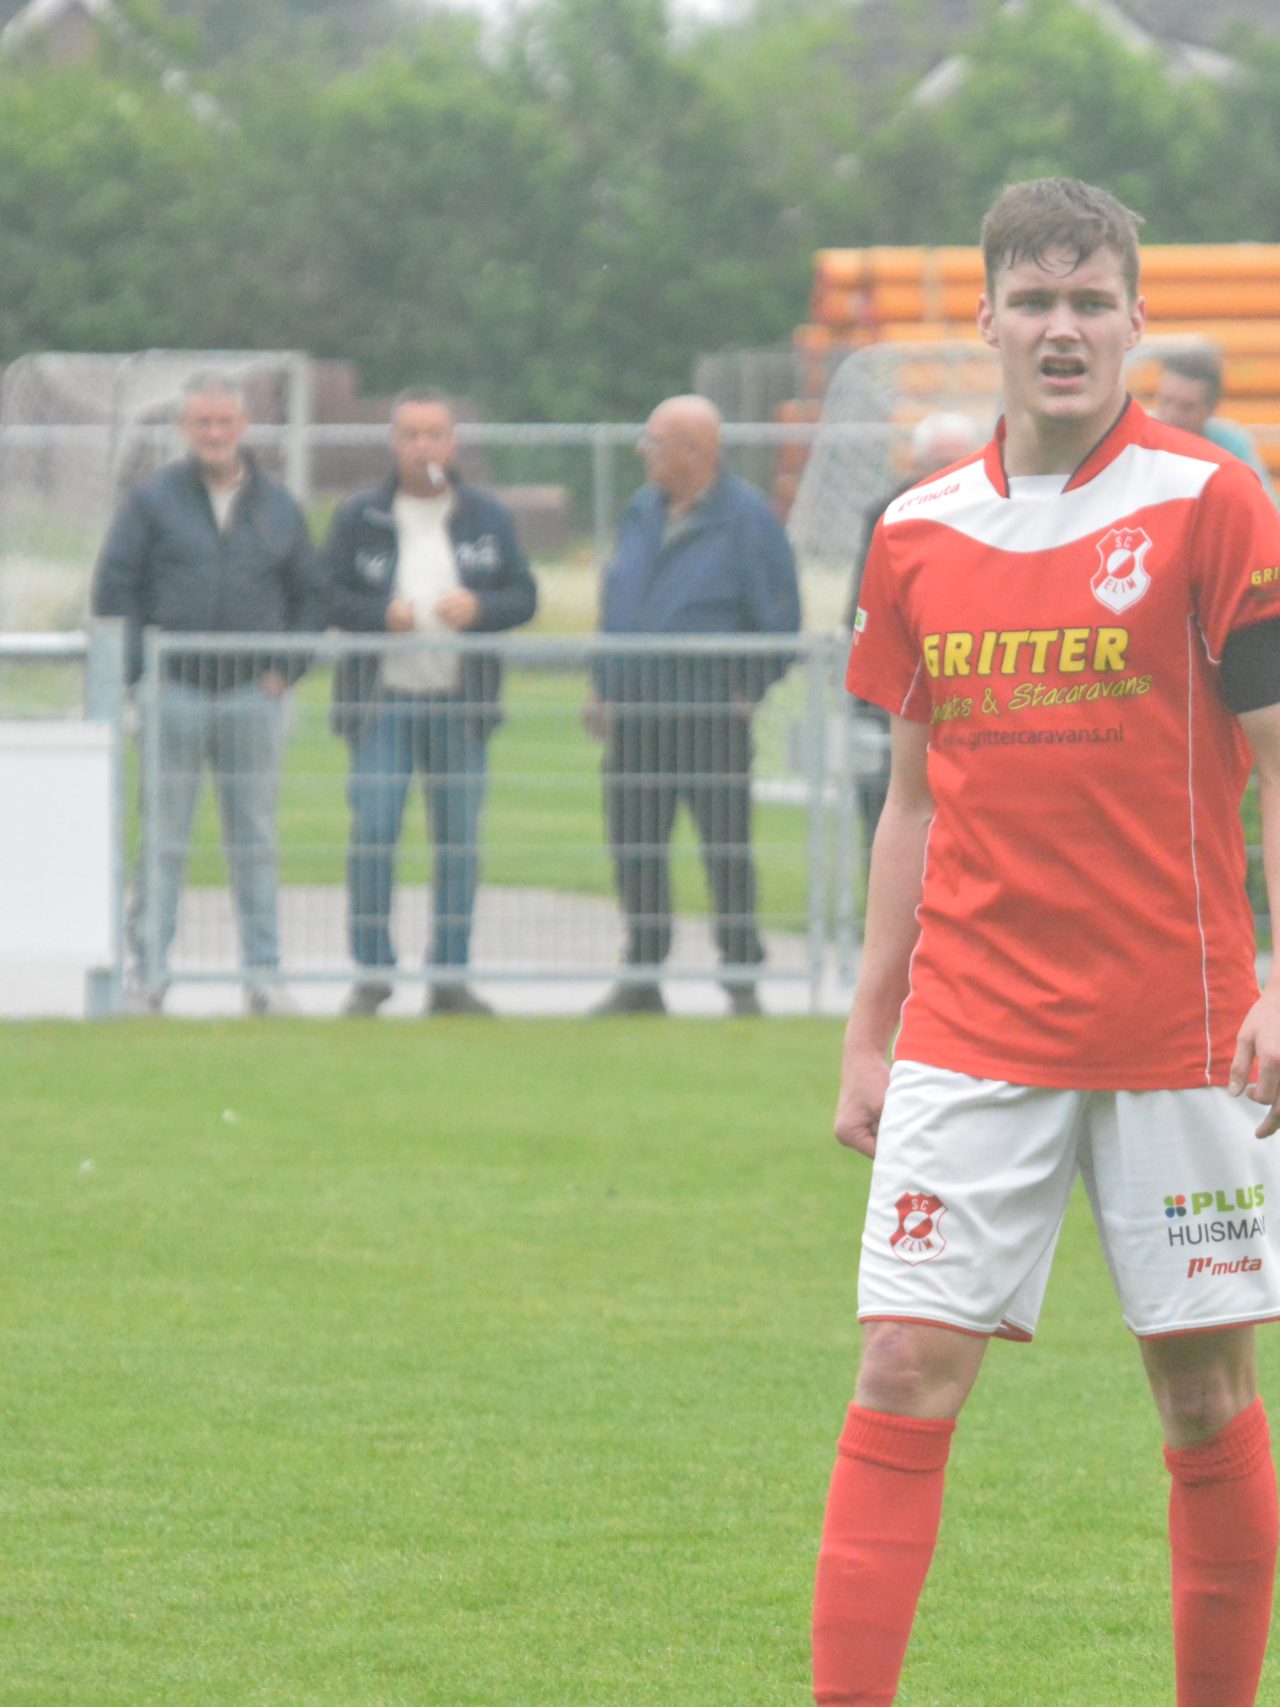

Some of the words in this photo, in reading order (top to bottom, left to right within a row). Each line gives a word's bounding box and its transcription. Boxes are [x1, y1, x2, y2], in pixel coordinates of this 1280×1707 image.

[923, 626, 1130, 678] GRITTER
[981, 687, 999, 715] &
[1007, 673, 1154, 712] Stacaravans
[1190, 1183, 1266, 1216] PLUS
[900, 1237, 934, 1253] ELIM
